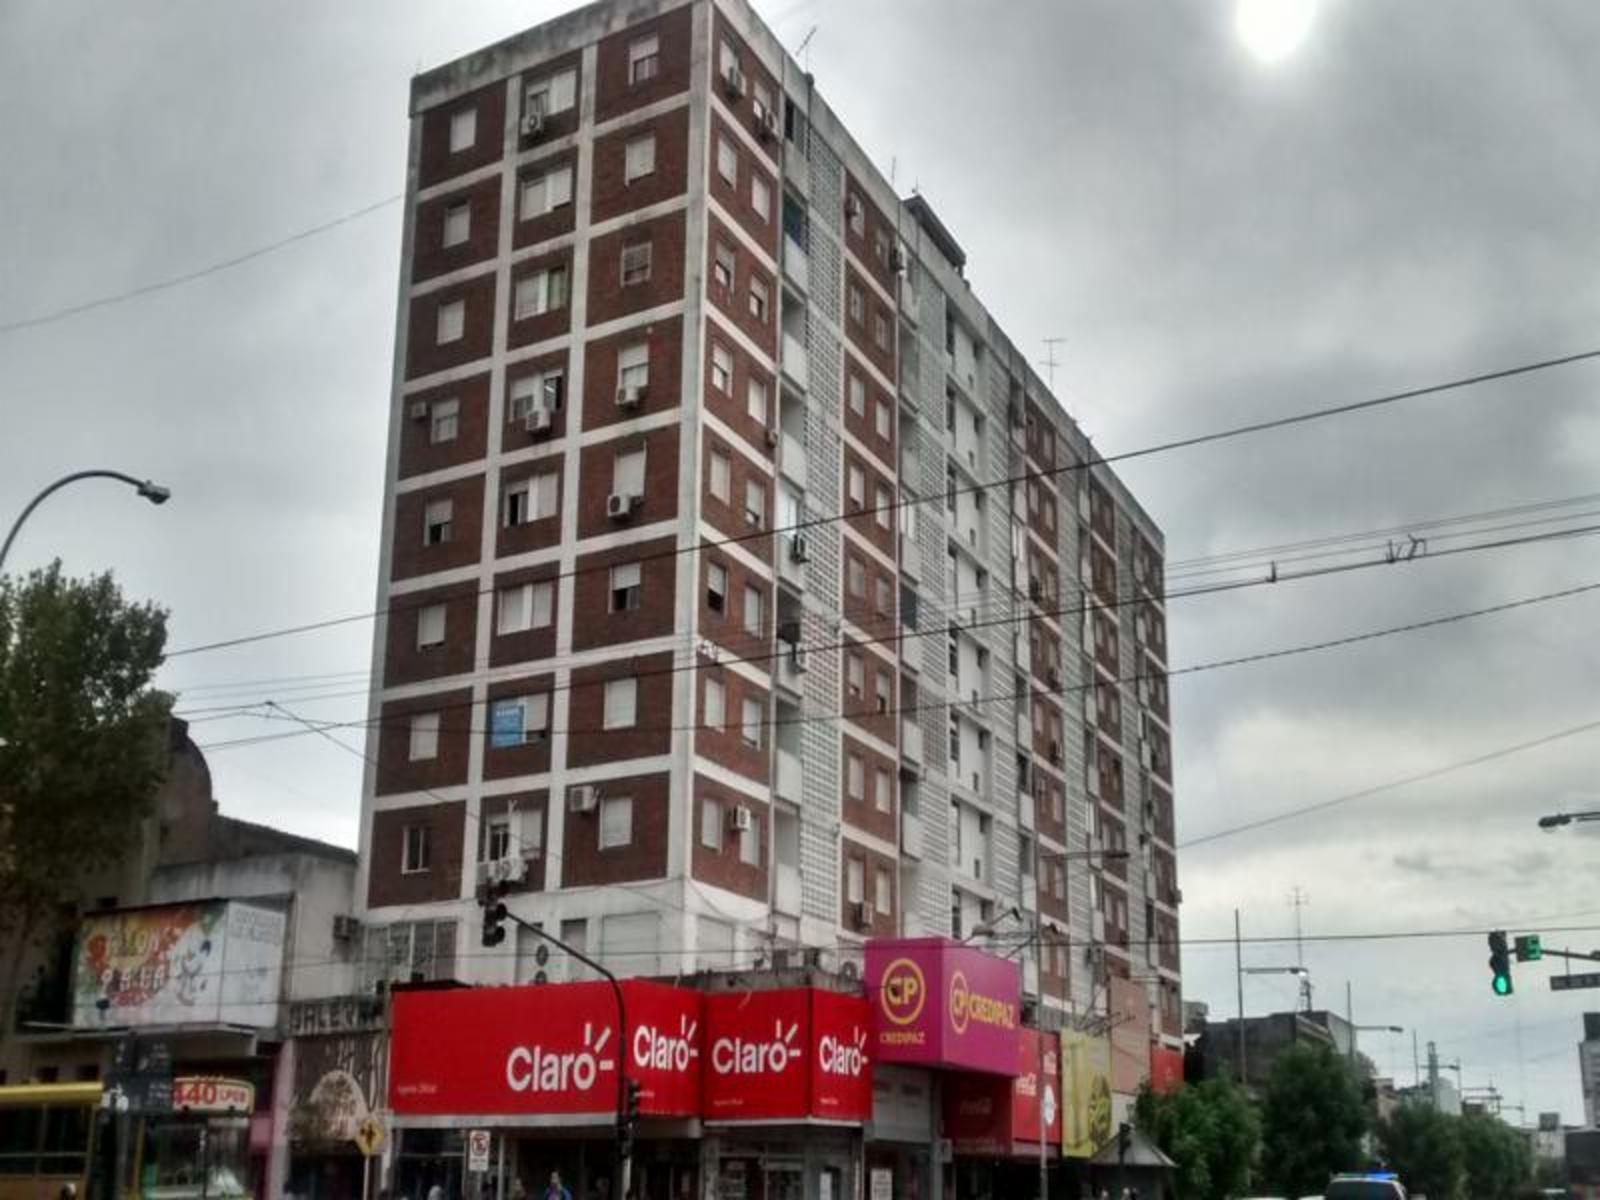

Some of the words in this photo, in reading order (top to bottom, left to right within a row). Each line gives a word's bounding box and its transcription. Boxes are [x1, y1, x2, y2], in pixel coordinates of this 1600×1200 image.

[887, 976, 918, 1005] CP
[506, 1045, 597, 1092] Claro
[633, 1025, 689, 1072] Claro
[712, 1038, 788, 1074] Claro
[819, 1036, 861, 1076] Claro
